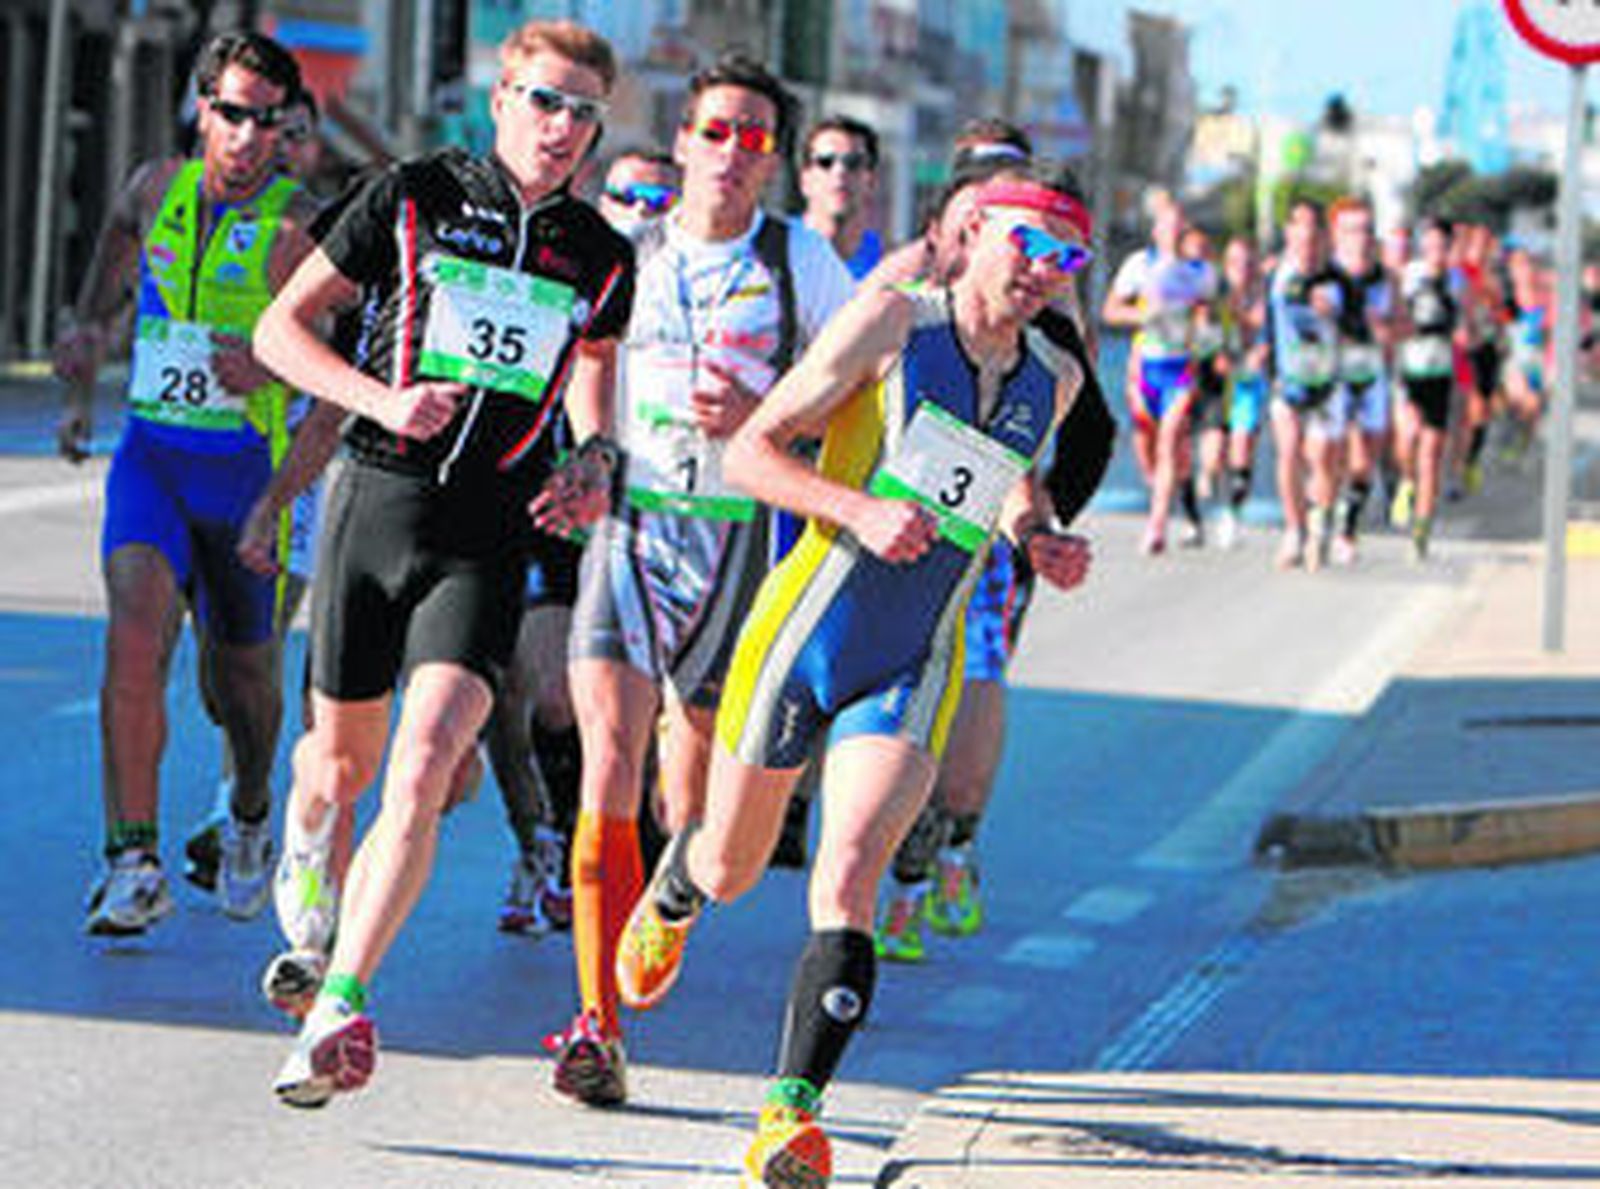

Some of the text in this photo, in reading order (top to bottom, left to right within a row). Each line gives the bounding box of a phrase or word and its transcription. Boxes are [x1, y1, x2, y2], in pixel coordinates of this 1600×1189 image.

[467, 316, 528, 365] 35
[160, 366, 208, 407] 28
[677, 456, 697, 492] 1
[939, 466, 974, 507] 3
